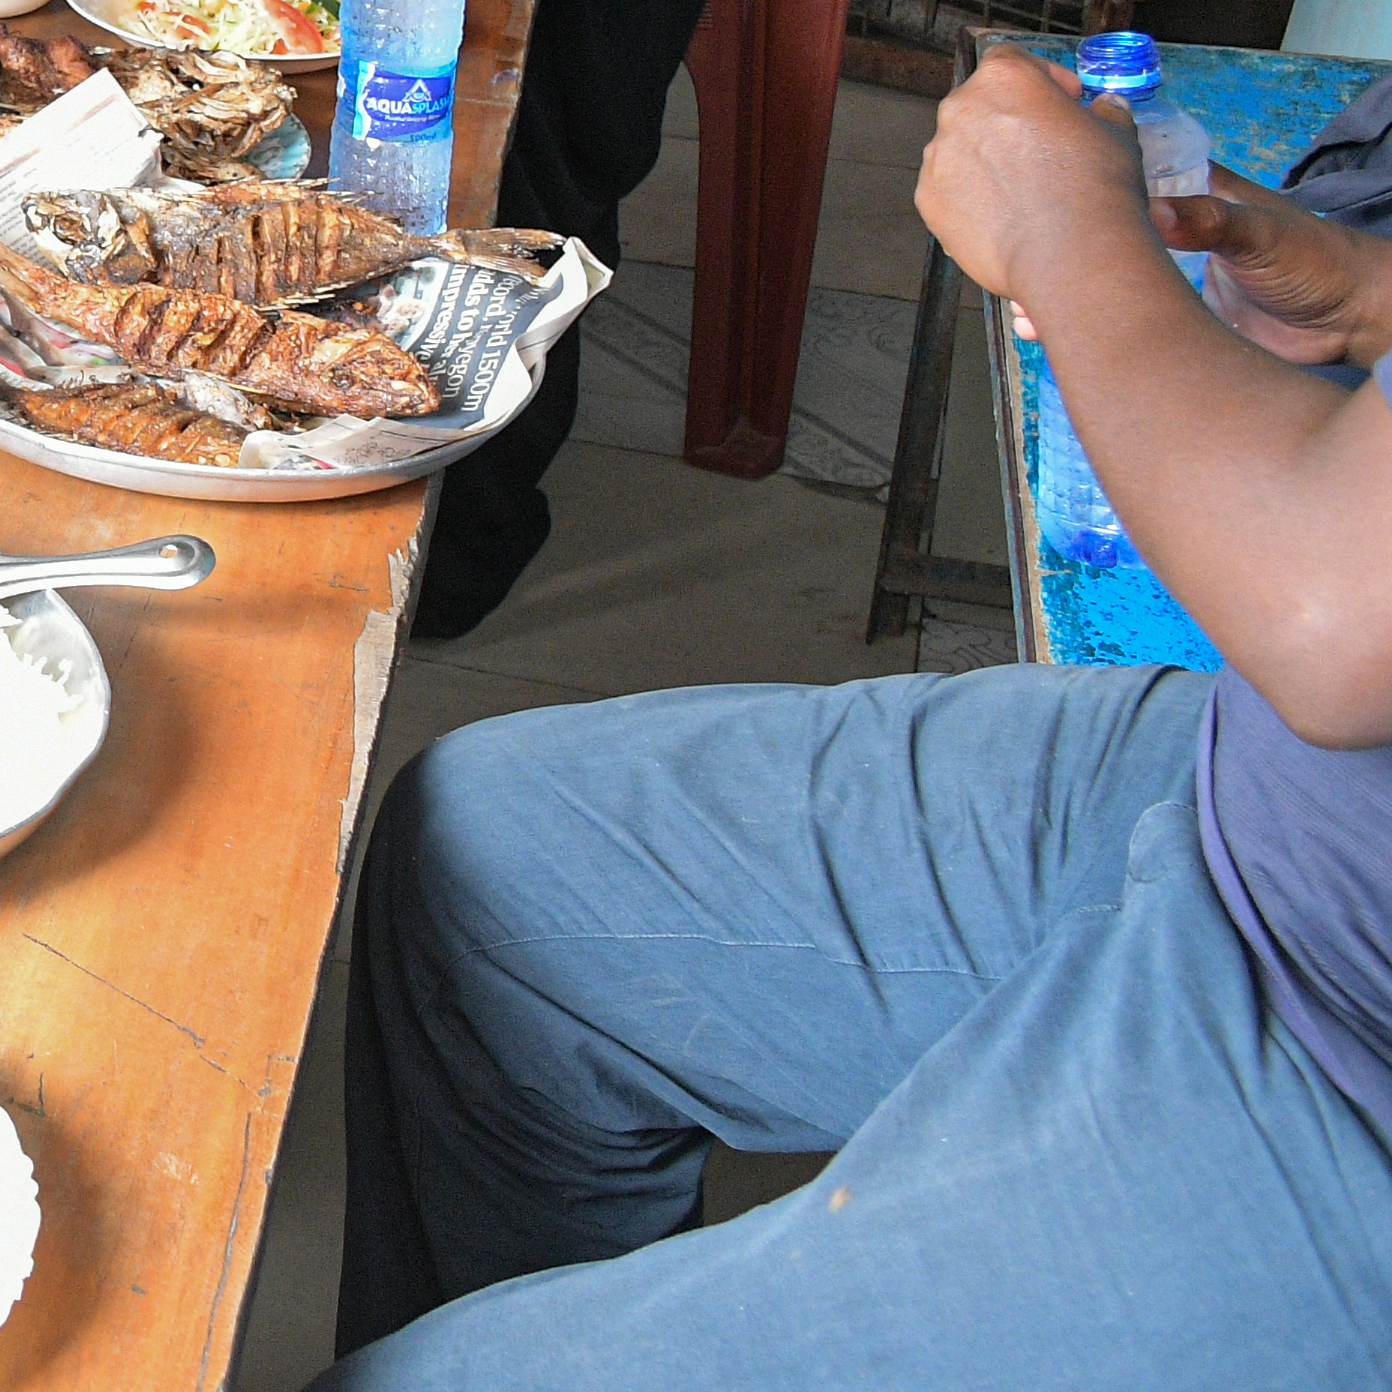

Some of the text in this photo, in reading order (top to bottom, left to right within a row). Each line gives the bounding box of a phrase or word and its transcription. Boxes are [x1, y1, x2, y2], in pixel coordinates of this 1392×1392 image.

[415, 263, 476, 362] impressive
[457, 309, 480, 331] to
[461, 350, 502, 412] 1500m
